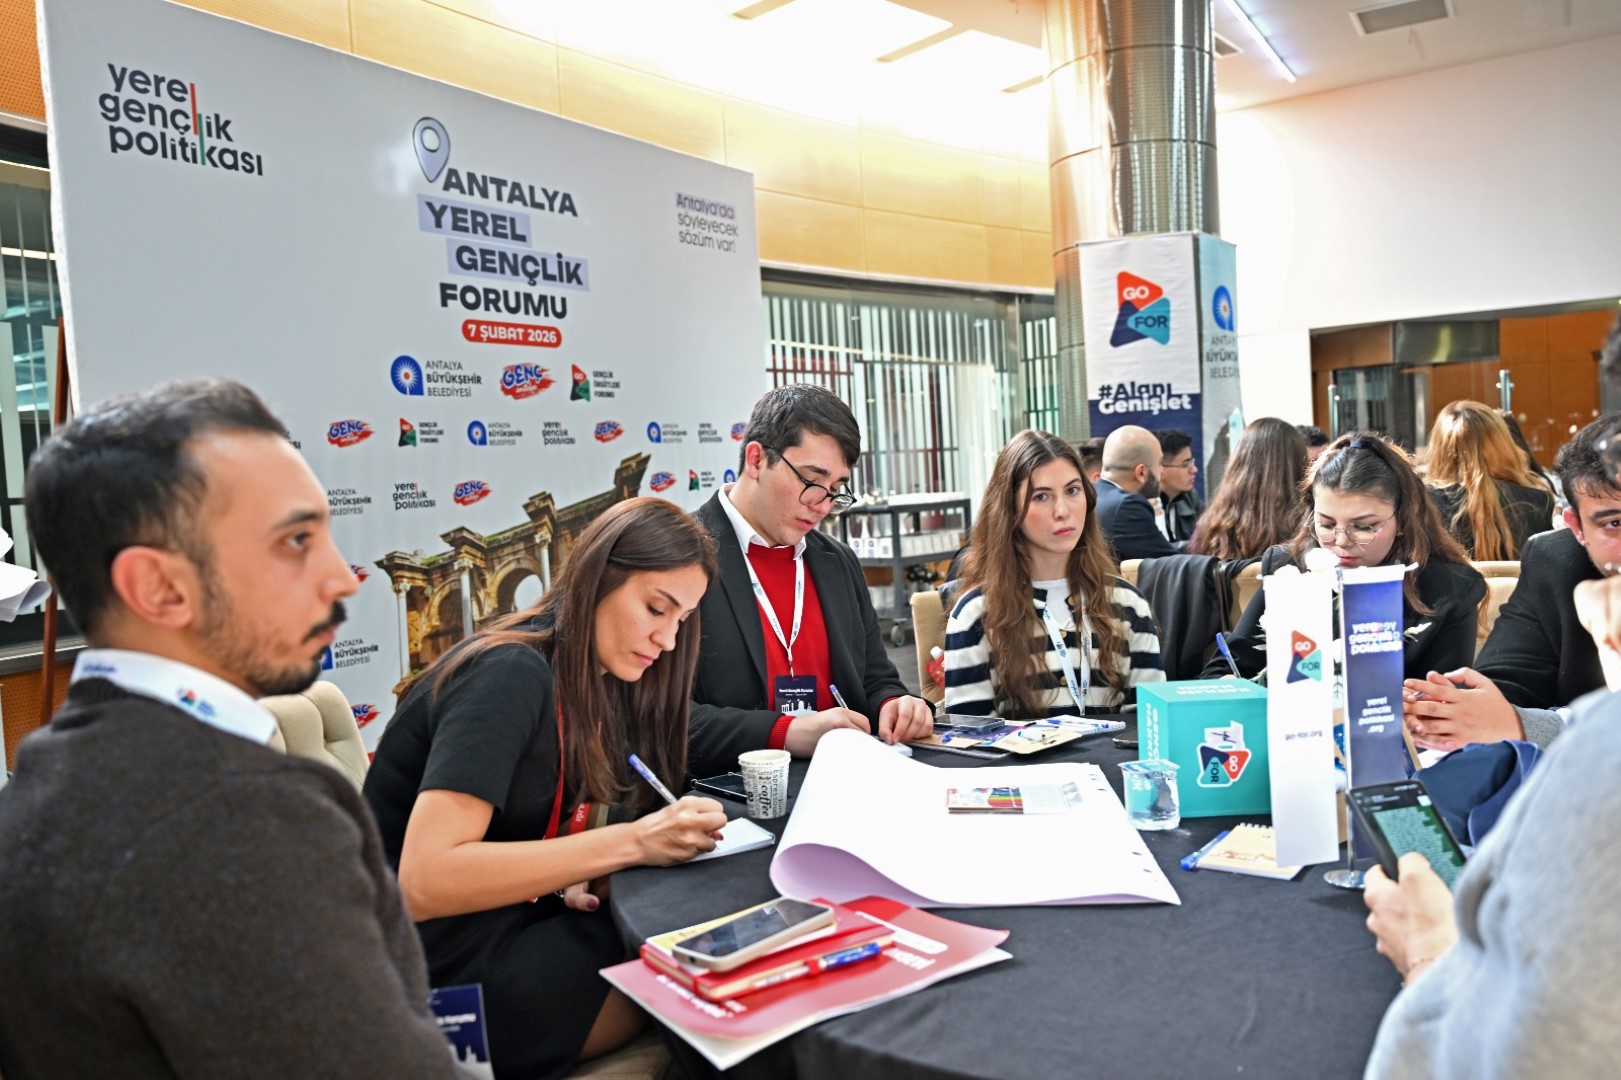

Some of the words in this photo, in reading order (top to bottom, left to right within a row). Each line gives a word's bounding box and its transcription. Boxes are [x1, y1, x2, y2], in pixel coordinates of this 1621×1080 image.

[107, 62, 198, 104] yerel
[98, 91, 234, 142] gençlik
[109, 124, 264, 176] politikası
[442, 167, 579, 218] ANTALYA
[676, 192, 735, 220] Antalya'da
[425, 201, 528, 243] YEREL
[677, 211, 738, 237] söyleyecek
[678, 229, 715, 249] sözüm
[455, 244, 584, 287] GENÇLİK
[439, 281, 568, 320] FORUMU
[1123, 285, 1150, 300] GO
[1134, 315, 1169, 329] FOR
[467, 323, 477, 338] 7
[480, 325, 525, 342] ŞUBAT
[527, 329, 557, 344] 2026
[425, 360, 464, 371] ANTALYA
[426, 372, 483, 386] BÜYÜKŞEHİR
[503, 364, 543, 388] GENÇ
[427, 386, 472, 397] BELEDİYESİ
[1098, 381, 1172, 400] #Alanı
[1098, 394, 1192, 416] Genişlet
[329, 420, 363, 438] GENÇ
[327, 488, 357, 496] ANTALYA
[454, 480, 483, 498] GENÇ
[334, 643, 379, 659] BÜYÜKŞEHİR
[335, 638, 364, 649] ANTALYA
[1294, 640, 1312, 652] GO
[335, 655, 371, 669] BELEDİYESİ
[1301, 662, 1321, 672] FOR
[1210, 761, 1220, 783] FOR
[1228, 755, 1239, 772] GO
[771, 770, 779, 806] Espresso
[759, 785, 772, 816] coffee
